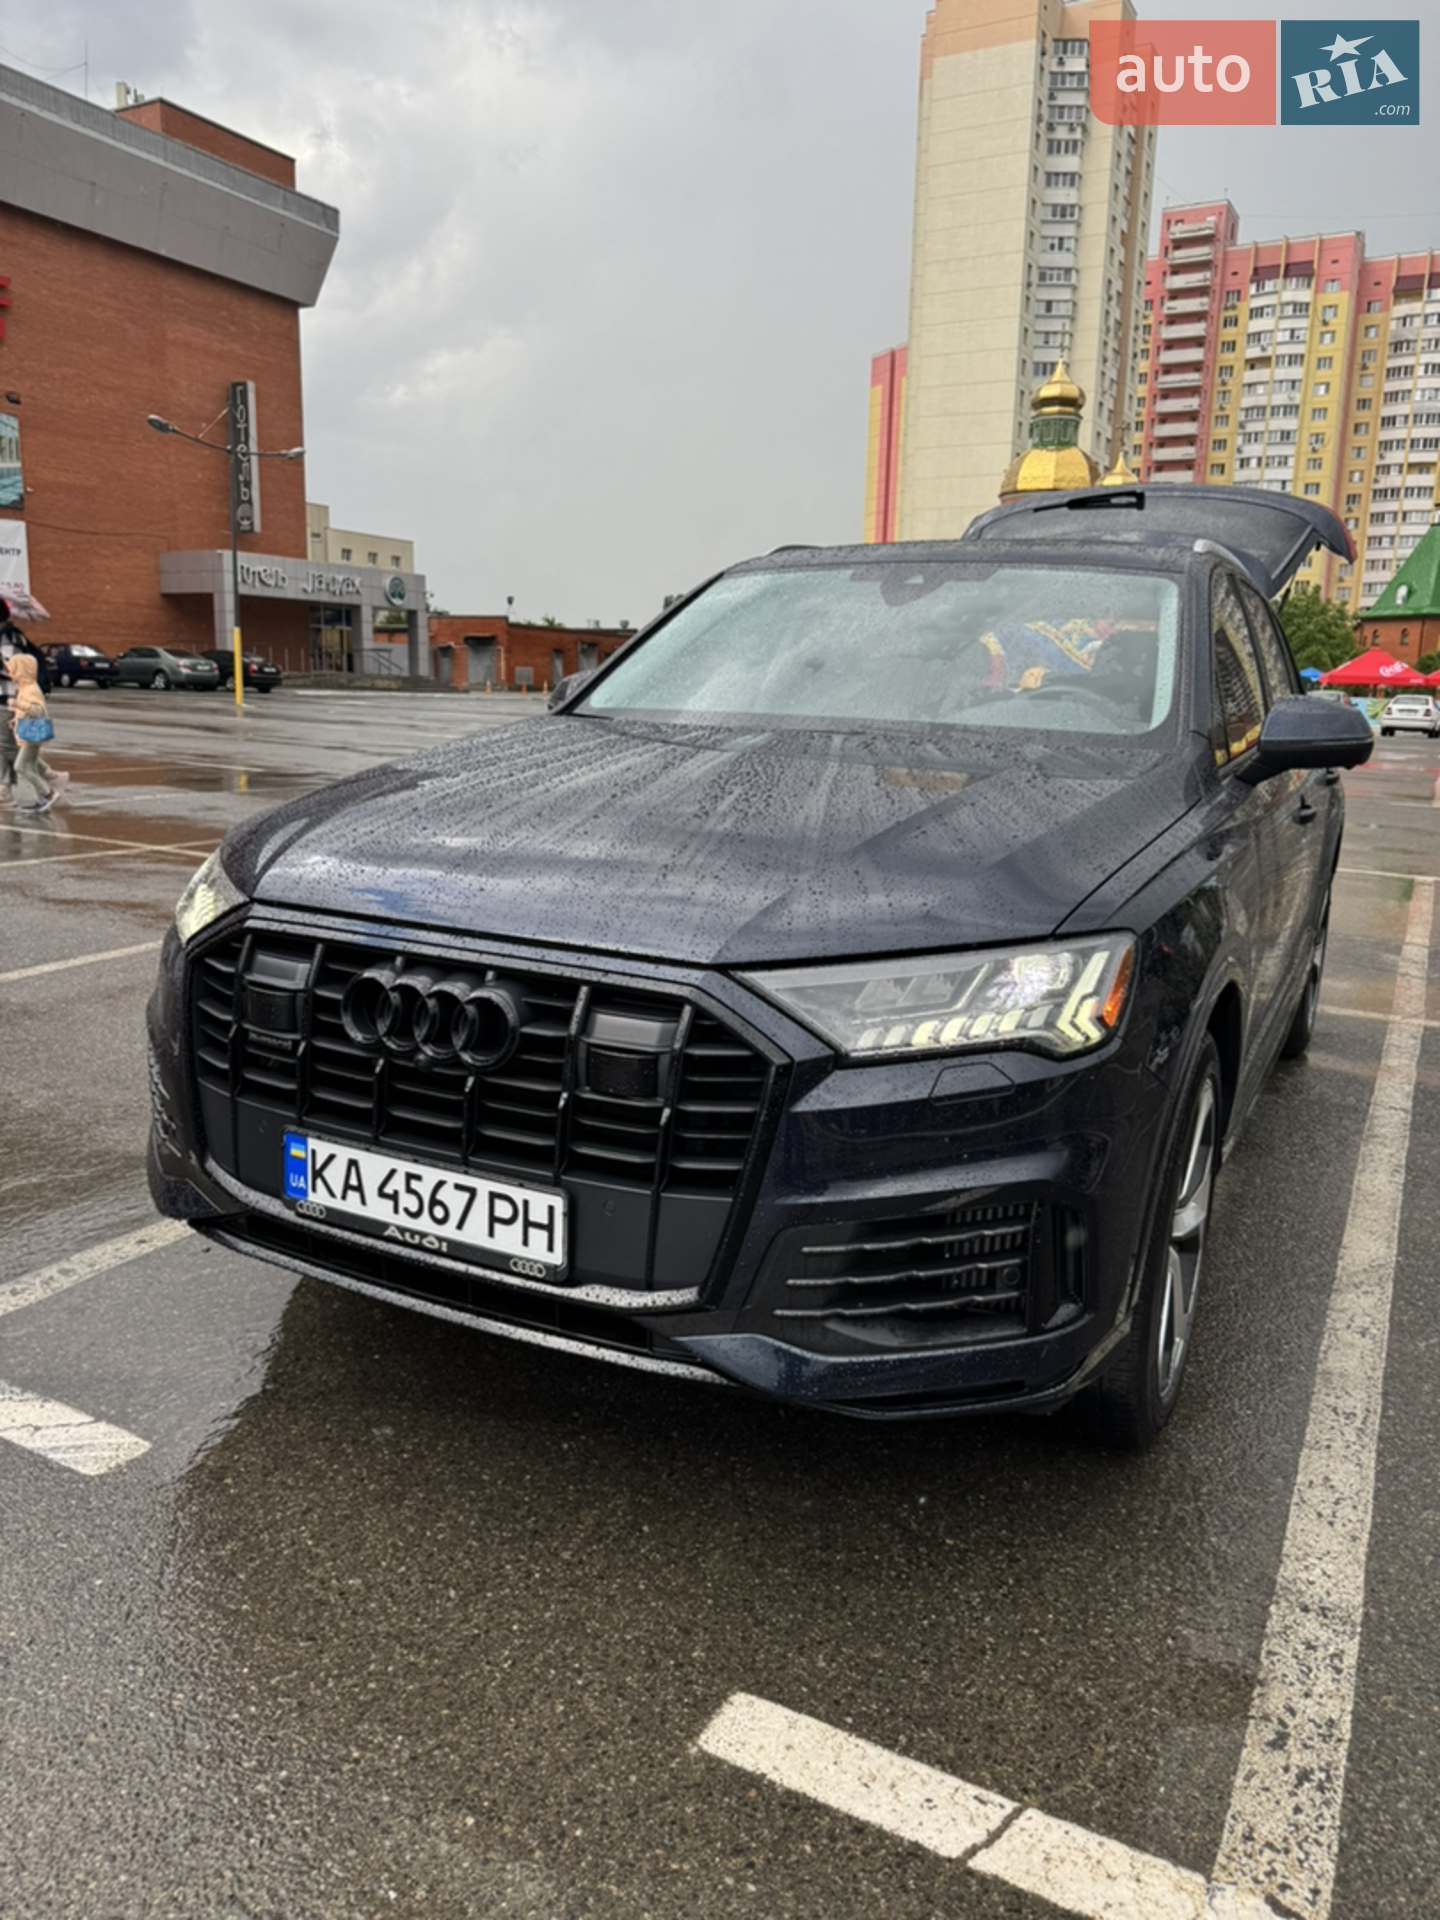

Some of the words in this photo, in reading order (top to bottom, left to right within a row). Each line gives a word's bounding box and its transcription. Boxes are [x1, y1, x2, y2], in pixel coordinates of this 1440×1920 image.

[290, 1173, 306, 1189] UA
[310, 1148, 367, 1206] KA
[377, 1168, 478, 1231] 4567
[488, 1190, 555, 1254] PH
[383, 1225, 448, 1252] Audi
